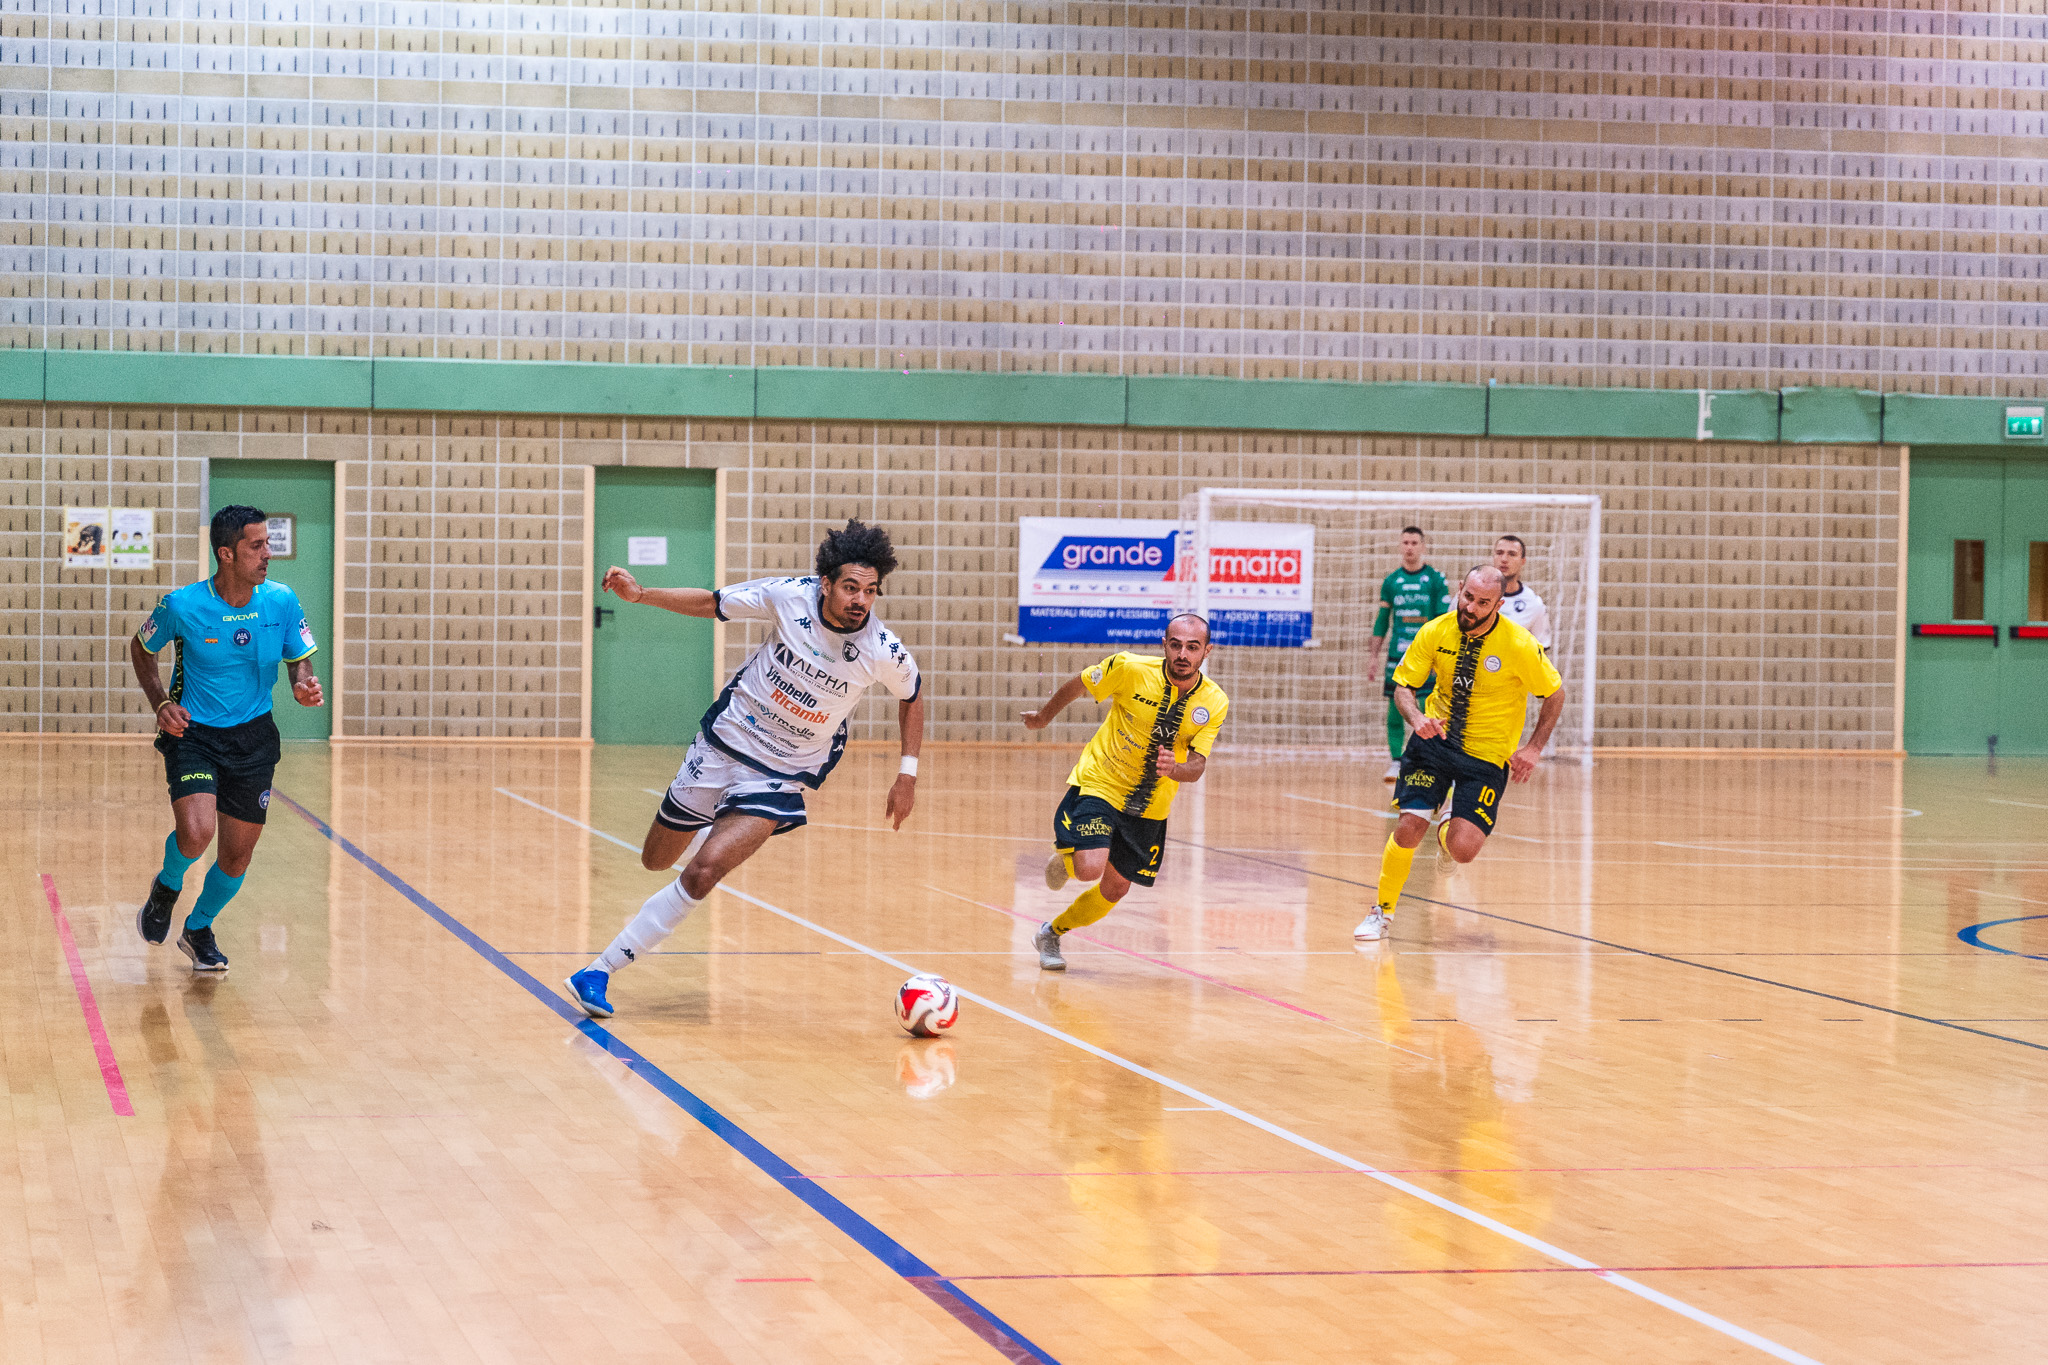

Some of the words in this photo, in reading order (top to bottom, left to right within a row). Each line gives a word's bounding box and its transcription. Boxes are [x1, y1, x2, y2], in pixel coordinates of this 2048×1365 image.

[1063, 541, 1163, 569] grande
[1194, 551, 1298, 577] rmato
[223, 612, 258, 622] GIVOVA
[1030, 607, 1077, 618] MATERIALI
[1436, 646, 1457, 656] Zeus
[792, 657, 848, 693] ALPHA
[766, 665, 818, 708] Vitobello
[770, 688, 831, 724] Ricambi
[1132, 693, 1160, 708] Zeus
[181, 772, 214, 782] GIVOVA
[1478, 785, 1496, 807] 10
[1474, 807, 1494, 826] Zeus
[1149, 845, 1160, 867] 2
